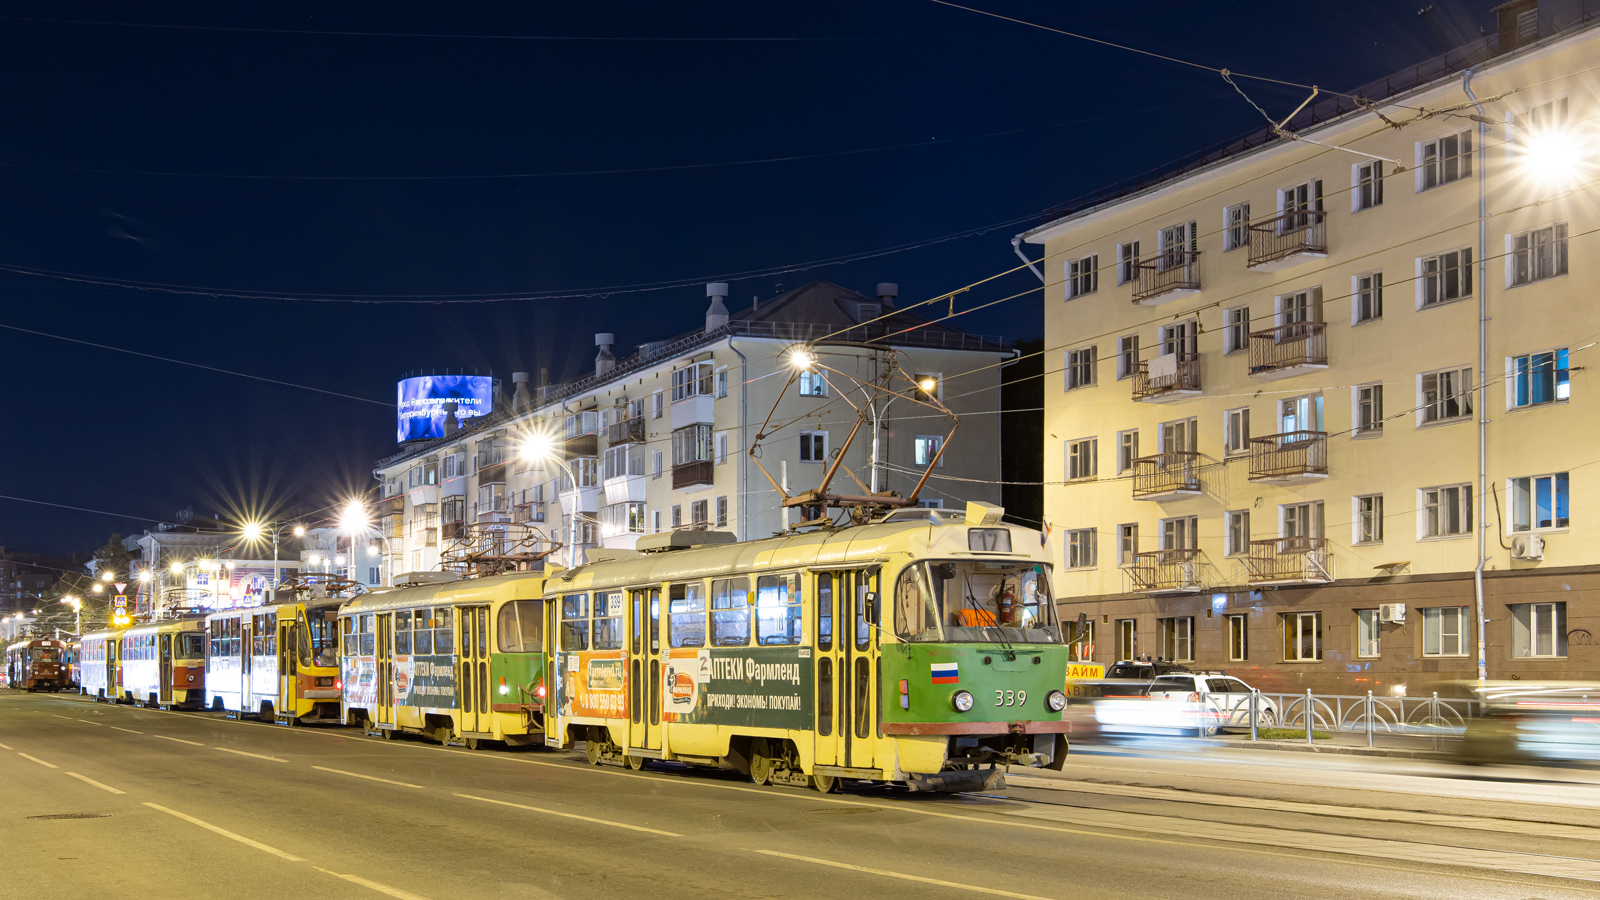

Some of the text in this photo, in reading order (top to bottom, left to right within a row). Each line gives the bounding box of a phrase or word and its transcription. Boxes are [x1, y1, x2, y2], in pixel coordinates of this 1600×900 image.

[610, 595, 621, 609] 339
[709, 657, 800, 686] АПТЕКИ Фармленд
[707, 692, 801, 710] ПРИХОДИ! ЭКОНОМЬ! ПОКУПАЙ!
[995, 690, 1027, 707] 339
